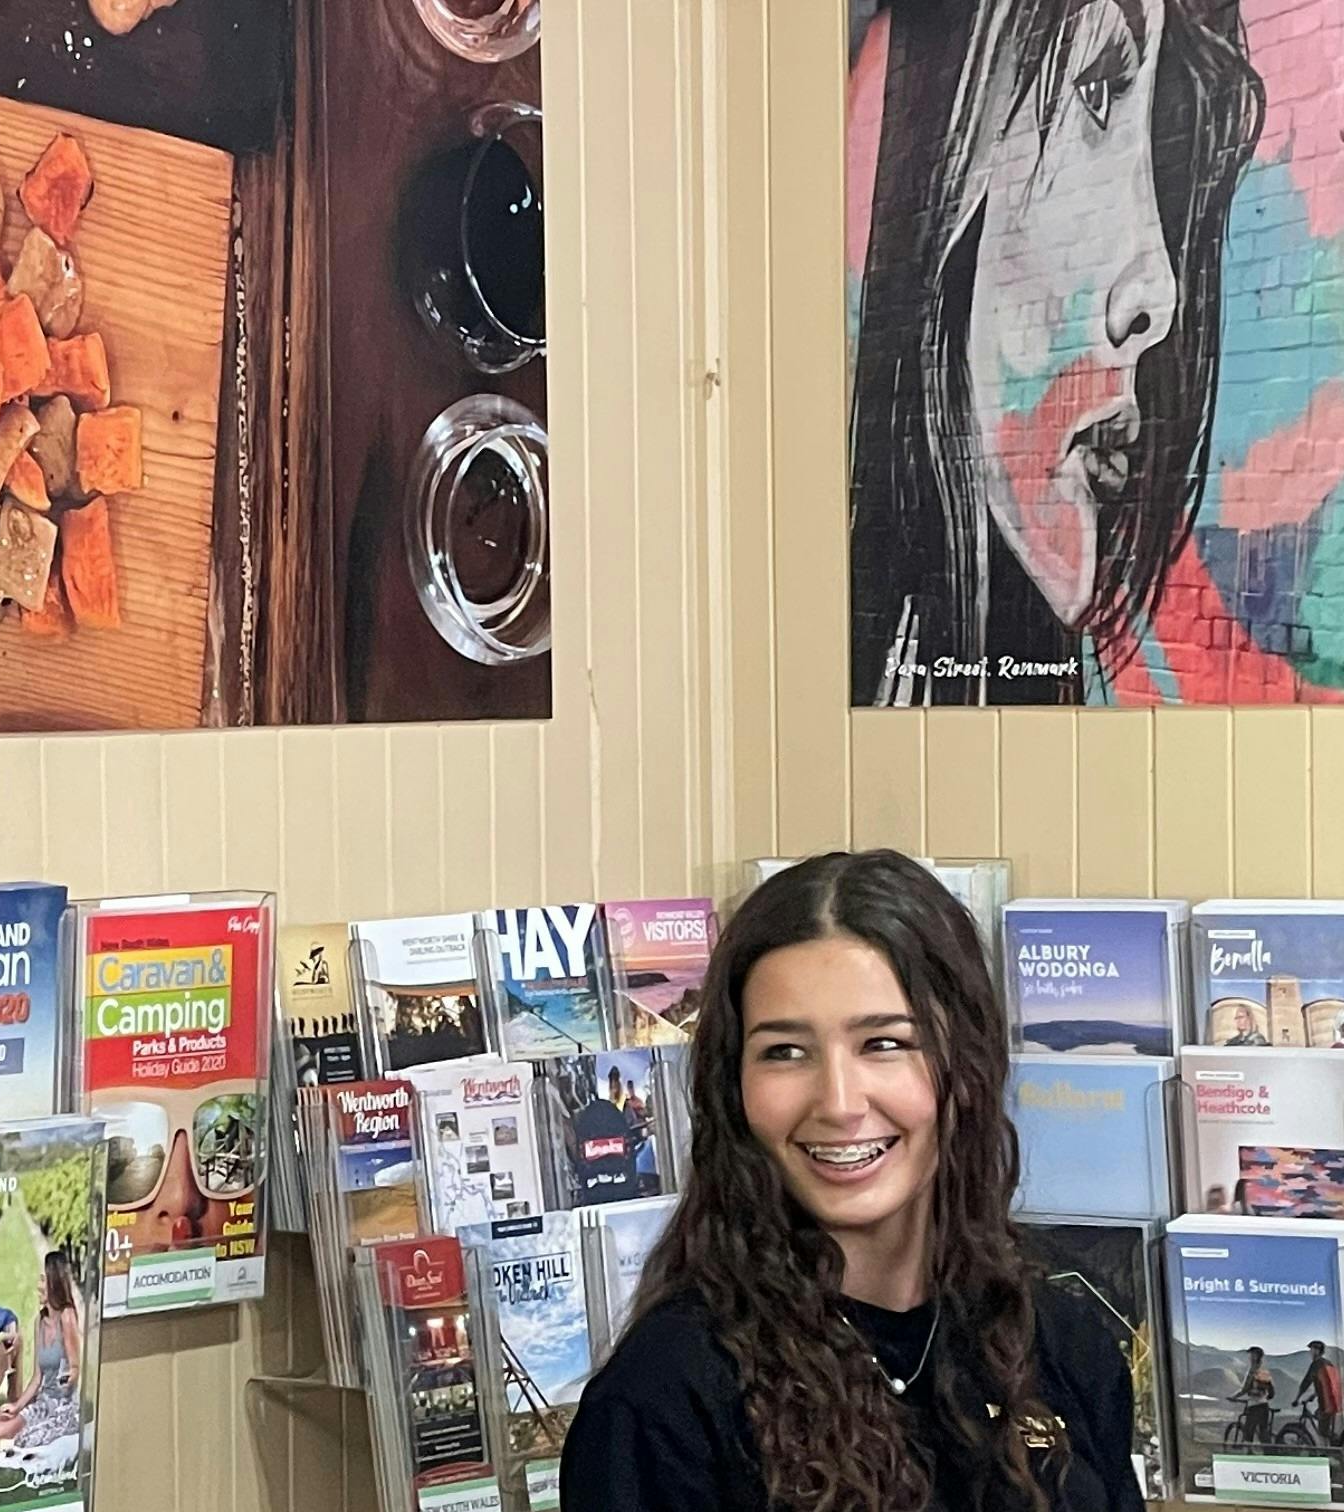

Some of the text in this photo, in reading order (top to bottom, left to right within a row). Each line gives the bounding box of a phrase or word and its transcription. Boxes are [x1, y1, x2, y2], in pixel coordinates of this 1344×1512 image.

[997, 656, 1080, 680] Renmark
[490, 904, 597, 980] HAY
[1018, 945, 1090, 961] ALBURY
[1018, 962, 1120, 977] WODONGA
[1209, 940, 1272, 975] Benalla
[99, 948, 226, 992] Caravan &
[97, 992, 226, 1037] Camping
[132, 1034, 227, 1057] Parks Products
[132, 1054, 226, 1078] Holiday Guide 2020
[337, 1086, 410, 1111] Wentworth
[460, 1076, 521, 1102] Wentworth
[1196, 1084, 1270, 1101] Bendigo &
[1197, 1099, 1271, 1116] Heathcote
[355, 1112, 400, 1139] Region
[133, 1265, 212, 1290] ACCOMODATION
[535, 1260, 570, 1282] HILL
[1183, 1276, 1327, 1297] Bright & Surrounds
[1240, 1471, 1301, 1486] VICTORIA
